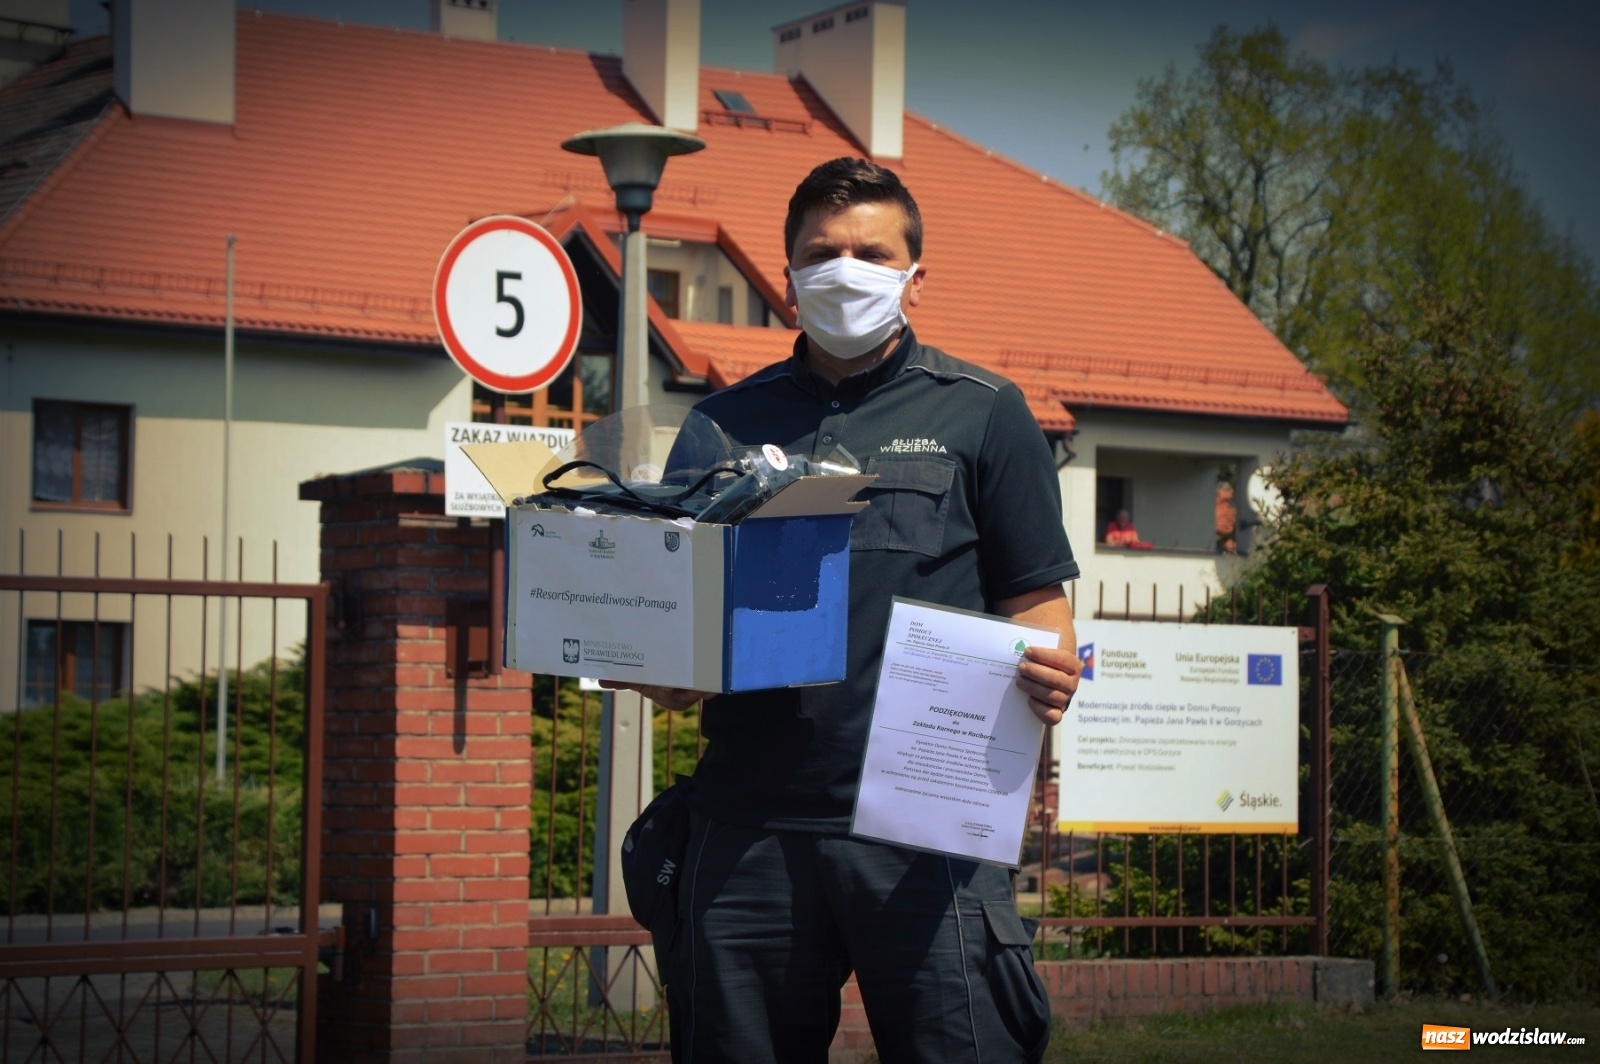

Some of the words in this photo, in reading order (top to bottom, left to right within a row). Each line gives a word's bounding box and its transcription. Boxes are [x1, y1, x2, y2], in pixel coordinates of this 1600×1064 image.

[495, 270, 525, 338] 5
[451, 427, 501, 443] ZAKAZ
[892, 437, 937, 446] SŁUŻBA
[880, 445, 947, 454] WIĘZIENNA
[530, 587, 677, 612] #ResortSprawiedliwosciPomaga
[583, 639, 633, 651] MINISTERSTWO
[583, 648, 645, 661] SPRAWIEDLIWOŚCI
[1101, 648, 1138, 659] Fundusze
[1175, 653, 1194, 662] Unia
[1196, 653, 1240, 664] Europejska
[1101, 660, 1147, 670] Europejskie
[929, 706, 987, 722] PODZIĘKOWANIE
[1078, 701, 1128, 712] Modernizacja
[1187, 704, 1210, 712] Domu
[1211, 704, 1241, 714] Pomocy
[1078, 714, 1120, 725] Społecznej
[1166, 717, 1184, 725] Jana
[1224, 717, 1263, 728] Gorzycach
[968, 730, 996, 741] Raciborzu
[656, 858, 676, 886] SW
